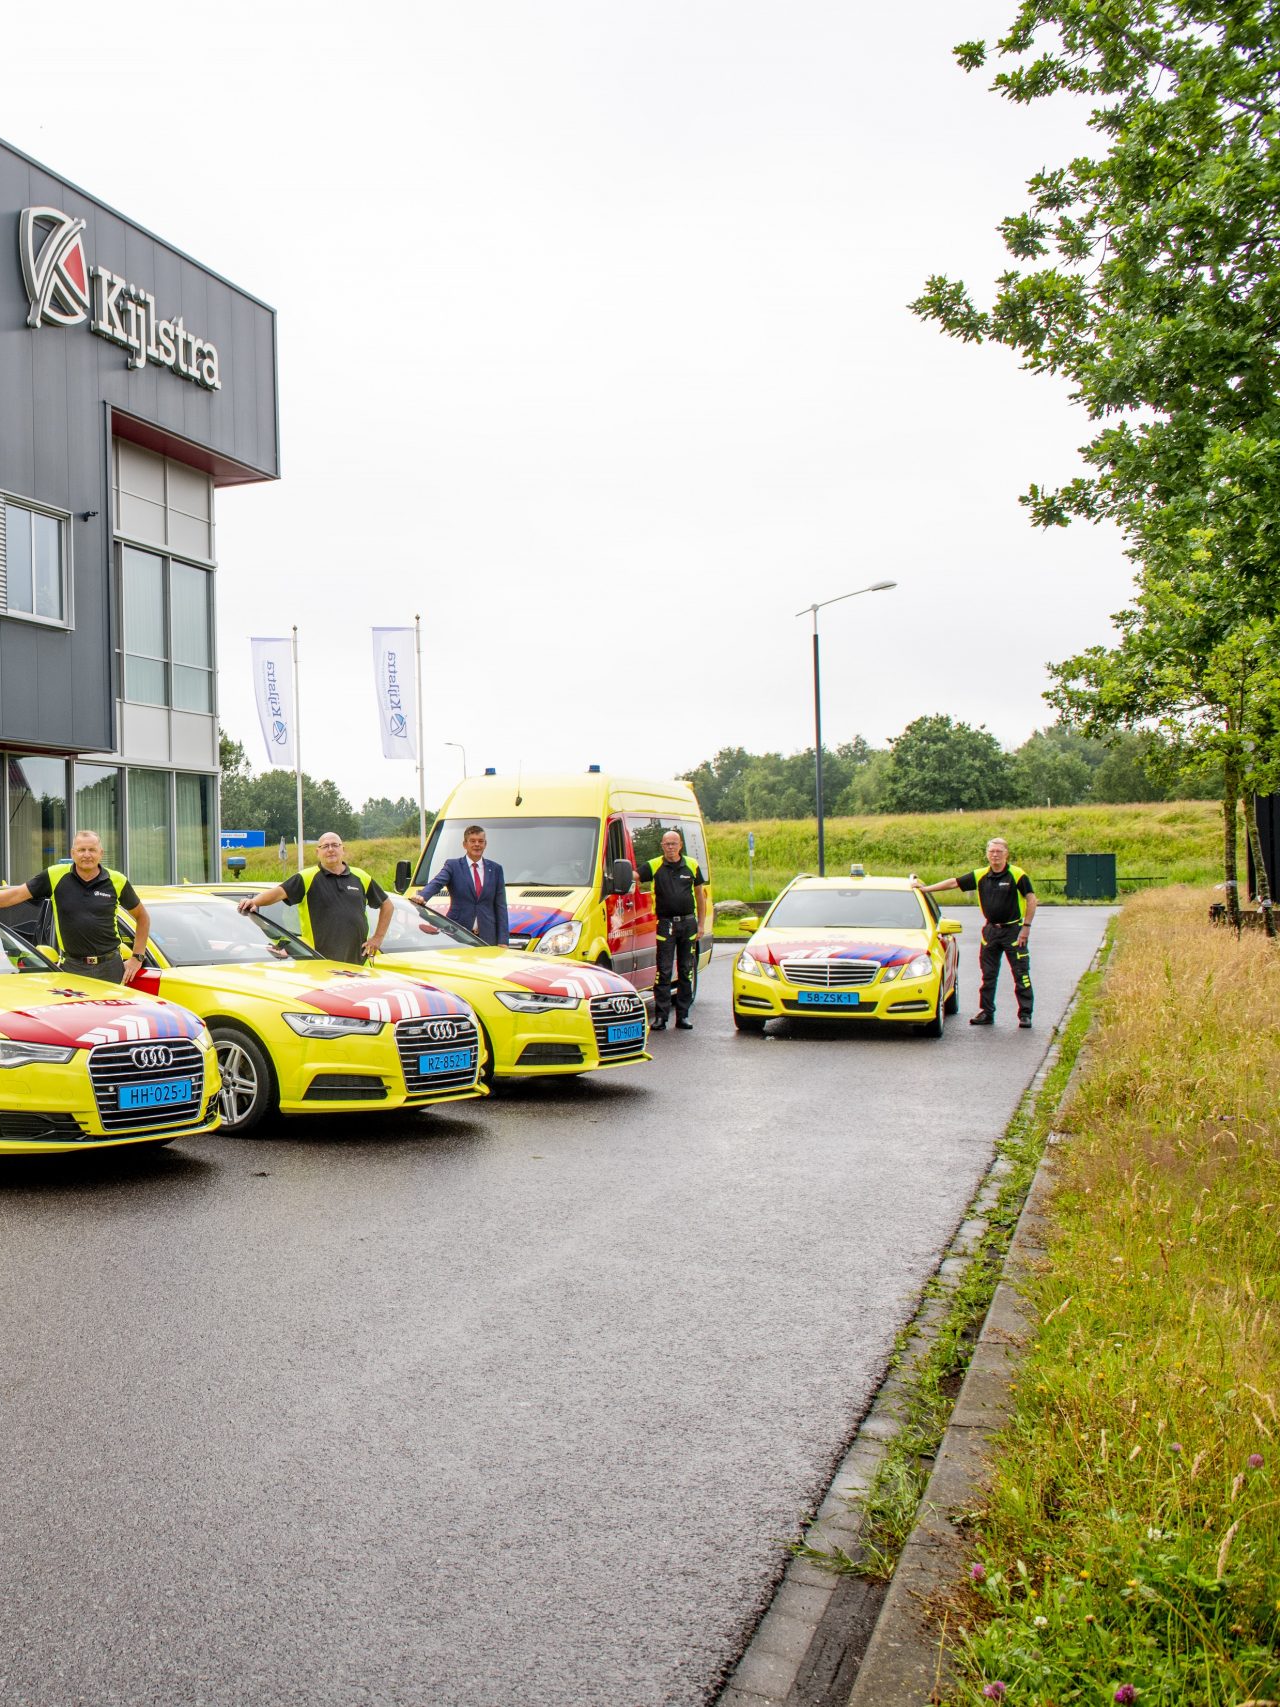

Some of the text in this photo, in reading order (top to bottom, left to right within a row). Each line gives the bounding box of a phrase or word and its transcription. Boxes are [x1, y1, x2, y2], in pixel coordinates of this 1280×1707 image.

[90, 265, 221, 392] Kijlstra
[807, 993, 851, 1003] 58-ZSK-1
[428, 1053, 467, 1071] RZ-852-T
[130, 1085, 187, 1105] HH-025-J
